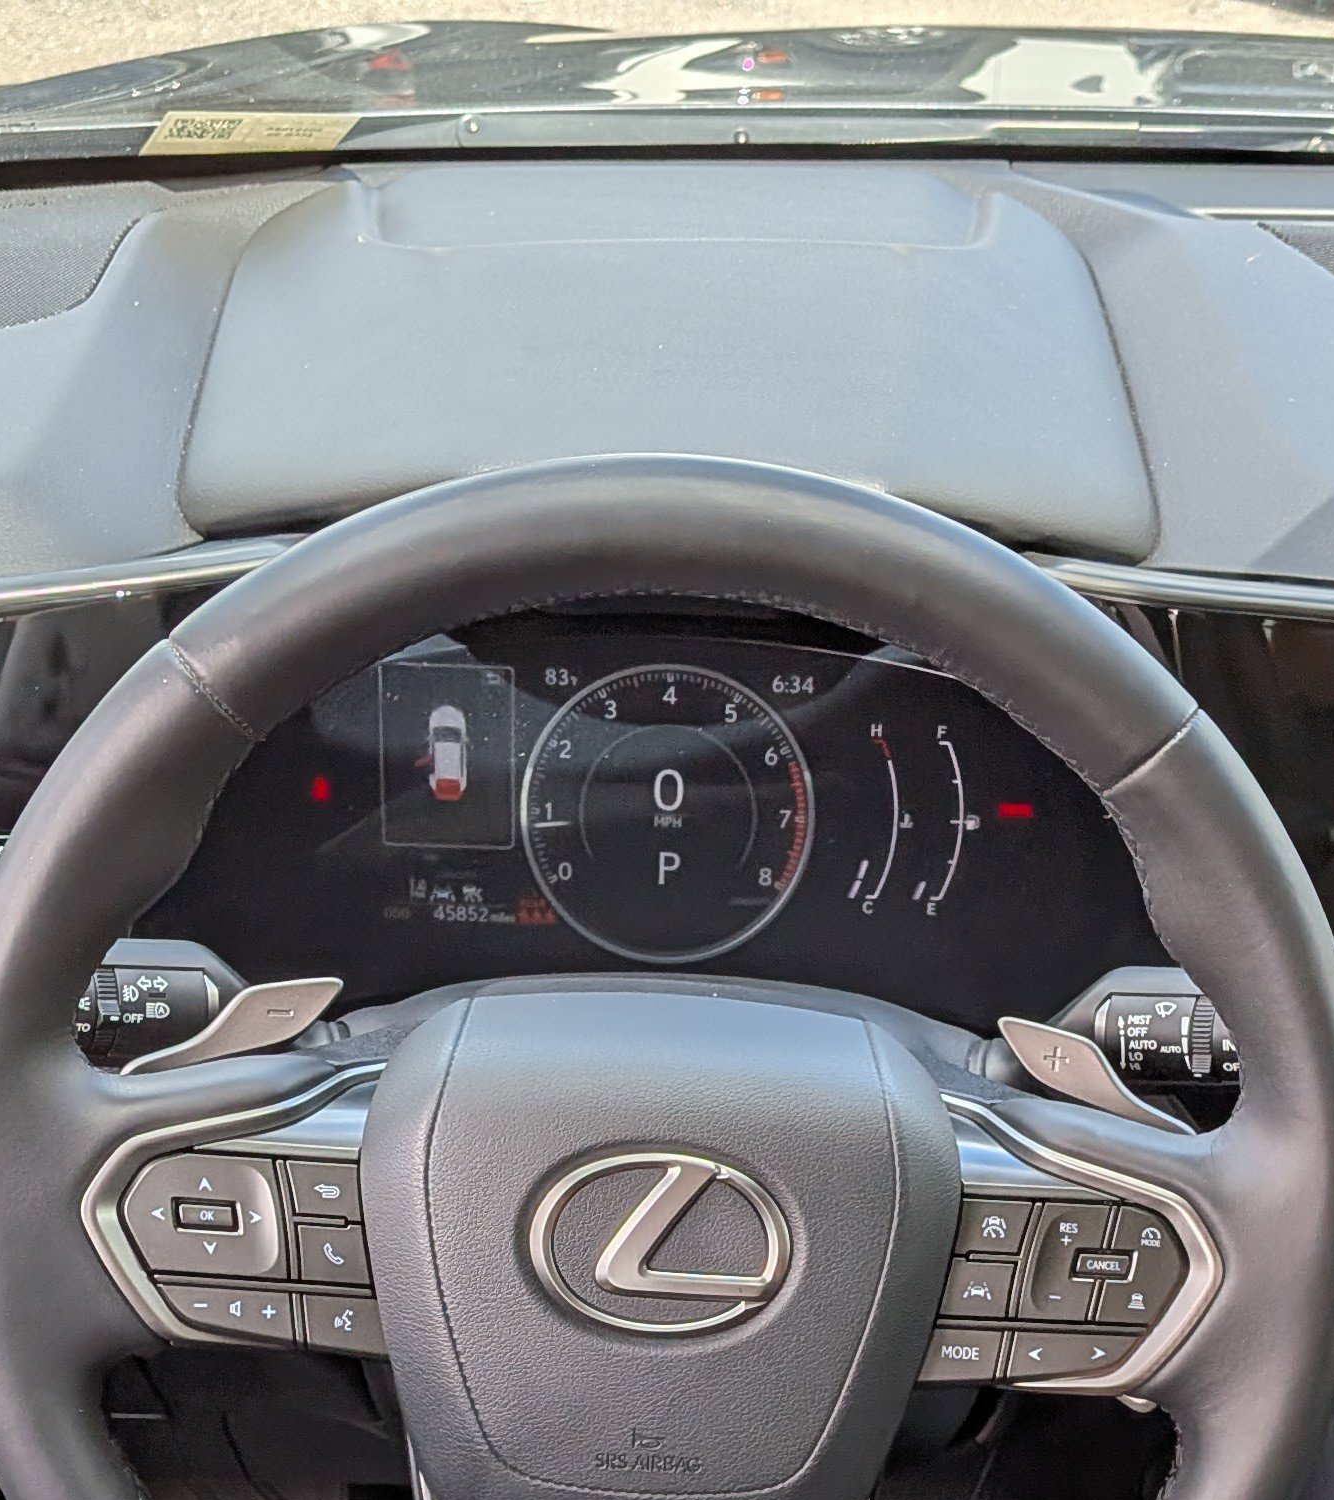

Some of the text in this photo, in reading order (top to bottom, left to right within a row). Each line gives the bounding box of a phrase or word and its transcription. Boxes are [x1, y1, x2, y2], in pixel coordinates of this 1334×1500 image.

[771, 675, 816, 695] 6:34
[662, 686, 678, 705] 4
[604, 700, 618, 720] 3
[724, 703, 739, 723] 5
[870, 723, 883, 737] H
[936, 725, 948, 739] F
[558, 739, 573, 759] 2
[763, 747, 779, 766] 6
[653, 768, 685, 812] 0
[544, 802, 553, 821] 1
[777, 809, 792, 829] 7
[653, 814, 683, 829] MPH
[558, 861, 573, 881] 0
[657, 851, 682, 886] P
[758, 867, 773, 887] 8
[432, 905, 490, 923] 45852
[861, 900, 874, 915] C
[925, 901, 938, 916] E
[122, 1011, 144, 1025] OFF
[1127, 1014, 1153, 1026] MIST
[1126, 1026, 1149, 1038] OFF
[1128, 1039, 1158, 1051] AUTO
[1159, 1044, 1182, 1055] AUTO
[1128, 1051, 1144, 1062] LO
[199, 1209, 215, 1222] OK
[1058, 1222, 1079, 1234] RES
[1139, 1238, 1161, 1249] MODE
[1085, 1259, 1122, 1272] CANCEL
[940, 1345, 980, 1361] MODE
[594, 1451, 703, 1475] SRS AIRBAG
